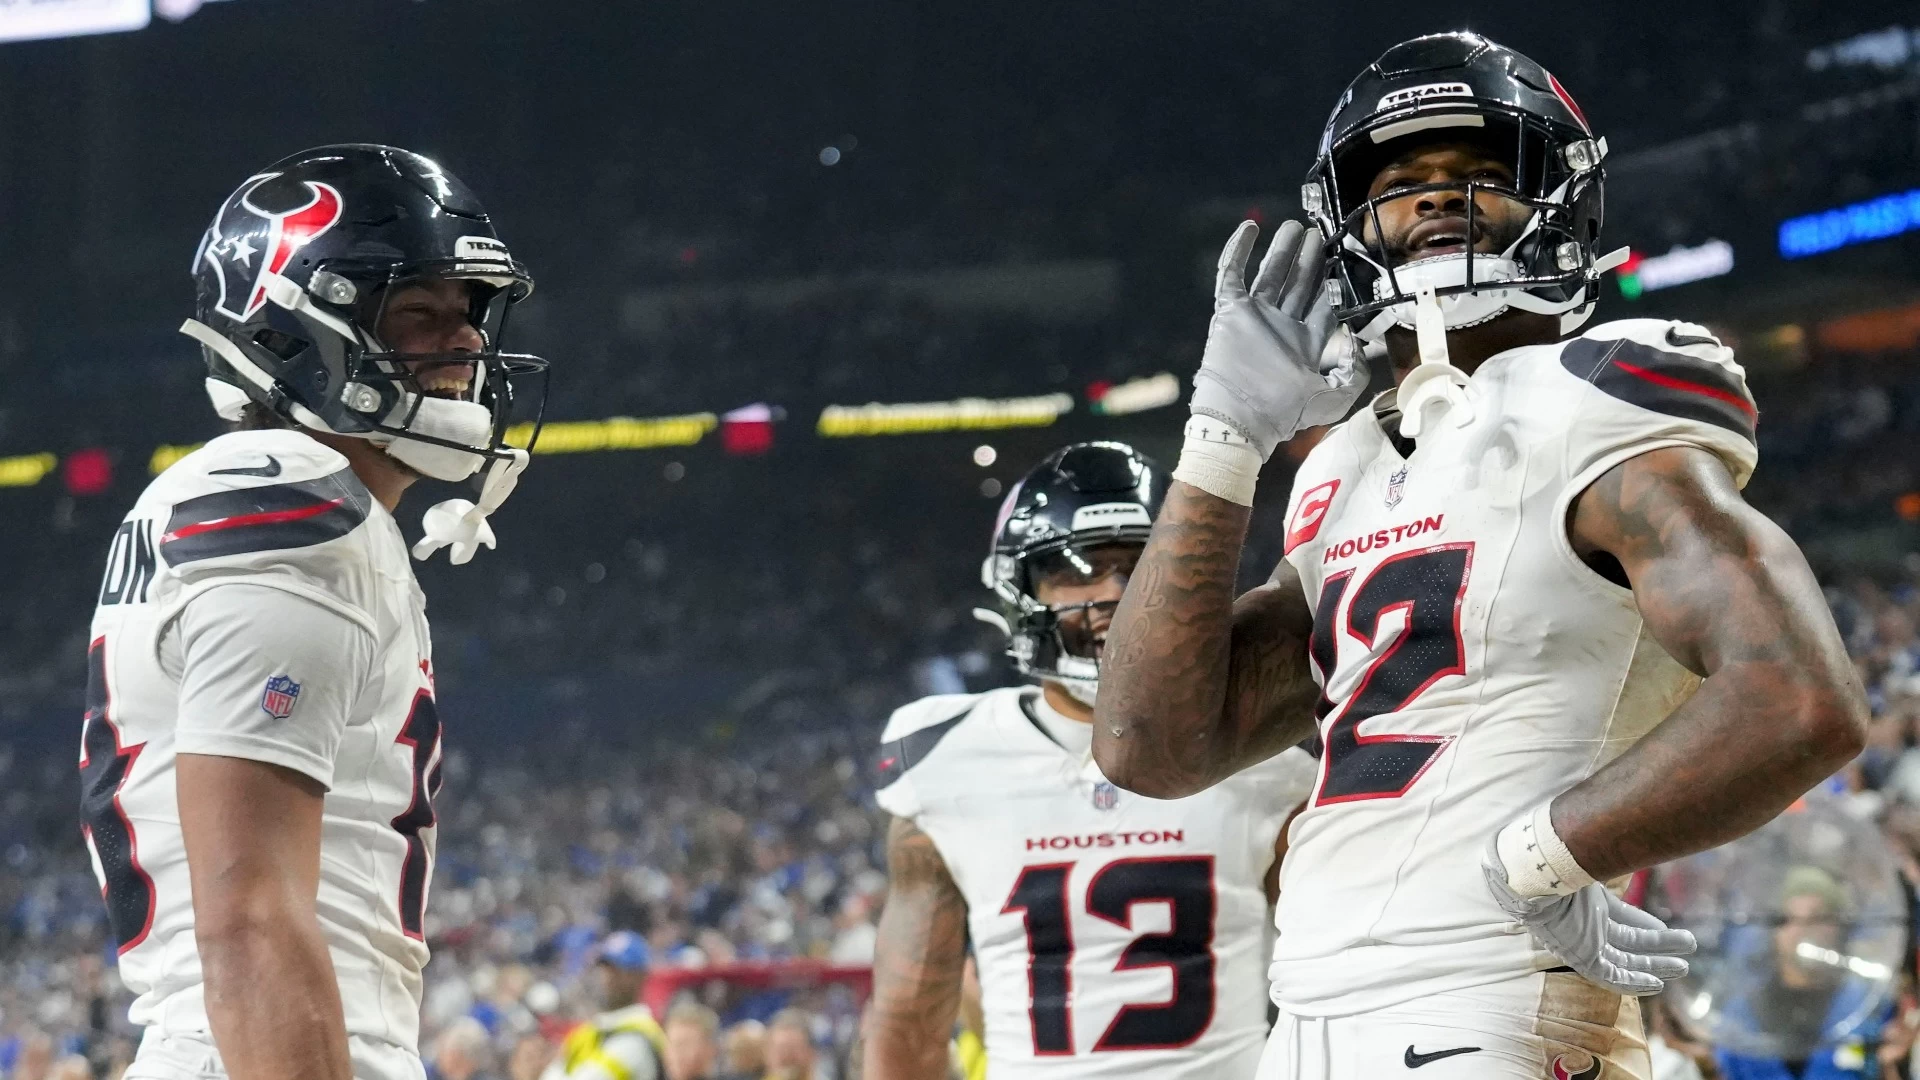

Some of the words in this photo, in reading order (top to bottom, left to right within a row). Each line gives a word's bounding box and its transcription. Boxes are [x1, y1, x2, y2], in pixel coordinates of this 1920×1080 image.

[1386, 86, 1464, 103] TEXANS
[1291, 485, 1333, 534] C
[1323, 513, 1445, 565] HOUSTON
[1310, 541, 1476, 808] 12
[264, 690, 293, 715] NFL
[1025, 829, 1185, 851] HOUSTON
[1000, 854, 1216, 1057] 13
